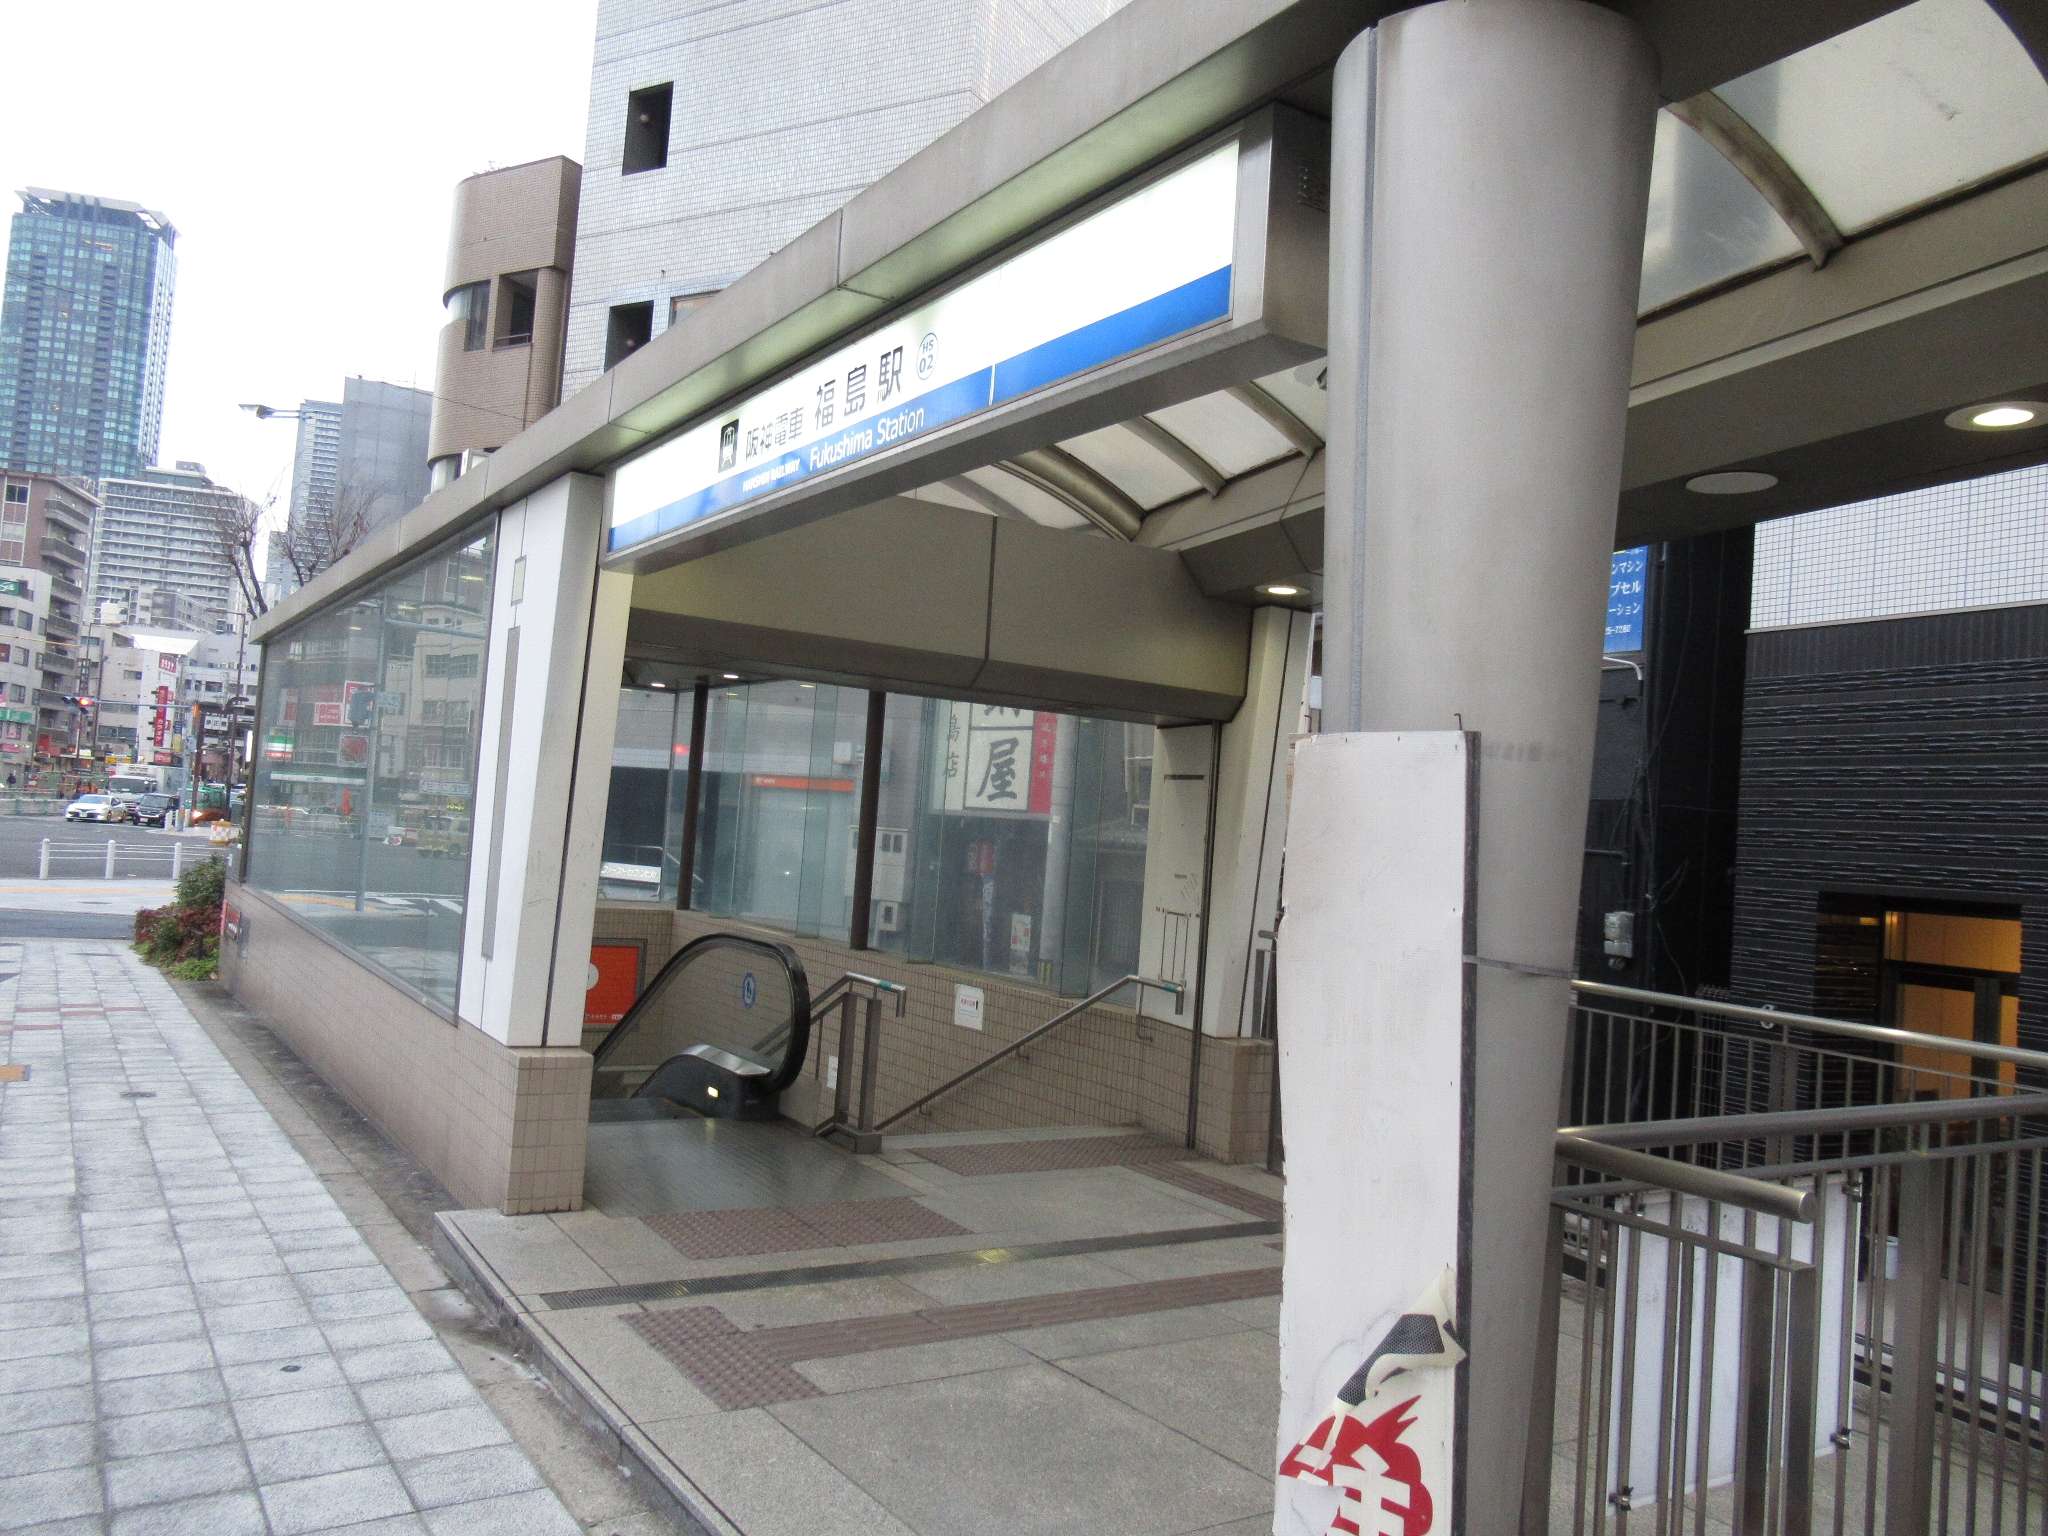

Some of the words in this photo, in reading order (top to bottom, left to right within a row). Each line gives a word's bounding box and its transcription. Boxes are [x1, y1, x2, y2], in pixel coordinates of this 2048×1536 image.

[919, 354, 934, 373] 02
[922, 339, 935, 353] HS
[745, 406, 806, 463] 阪神電車
[814, 345, 904, 430] 福島駅
[809, 428, 873, 471] Fukushima
[876, 407, 925, 445] Station
[975, 706, 1021, 803] 屋
